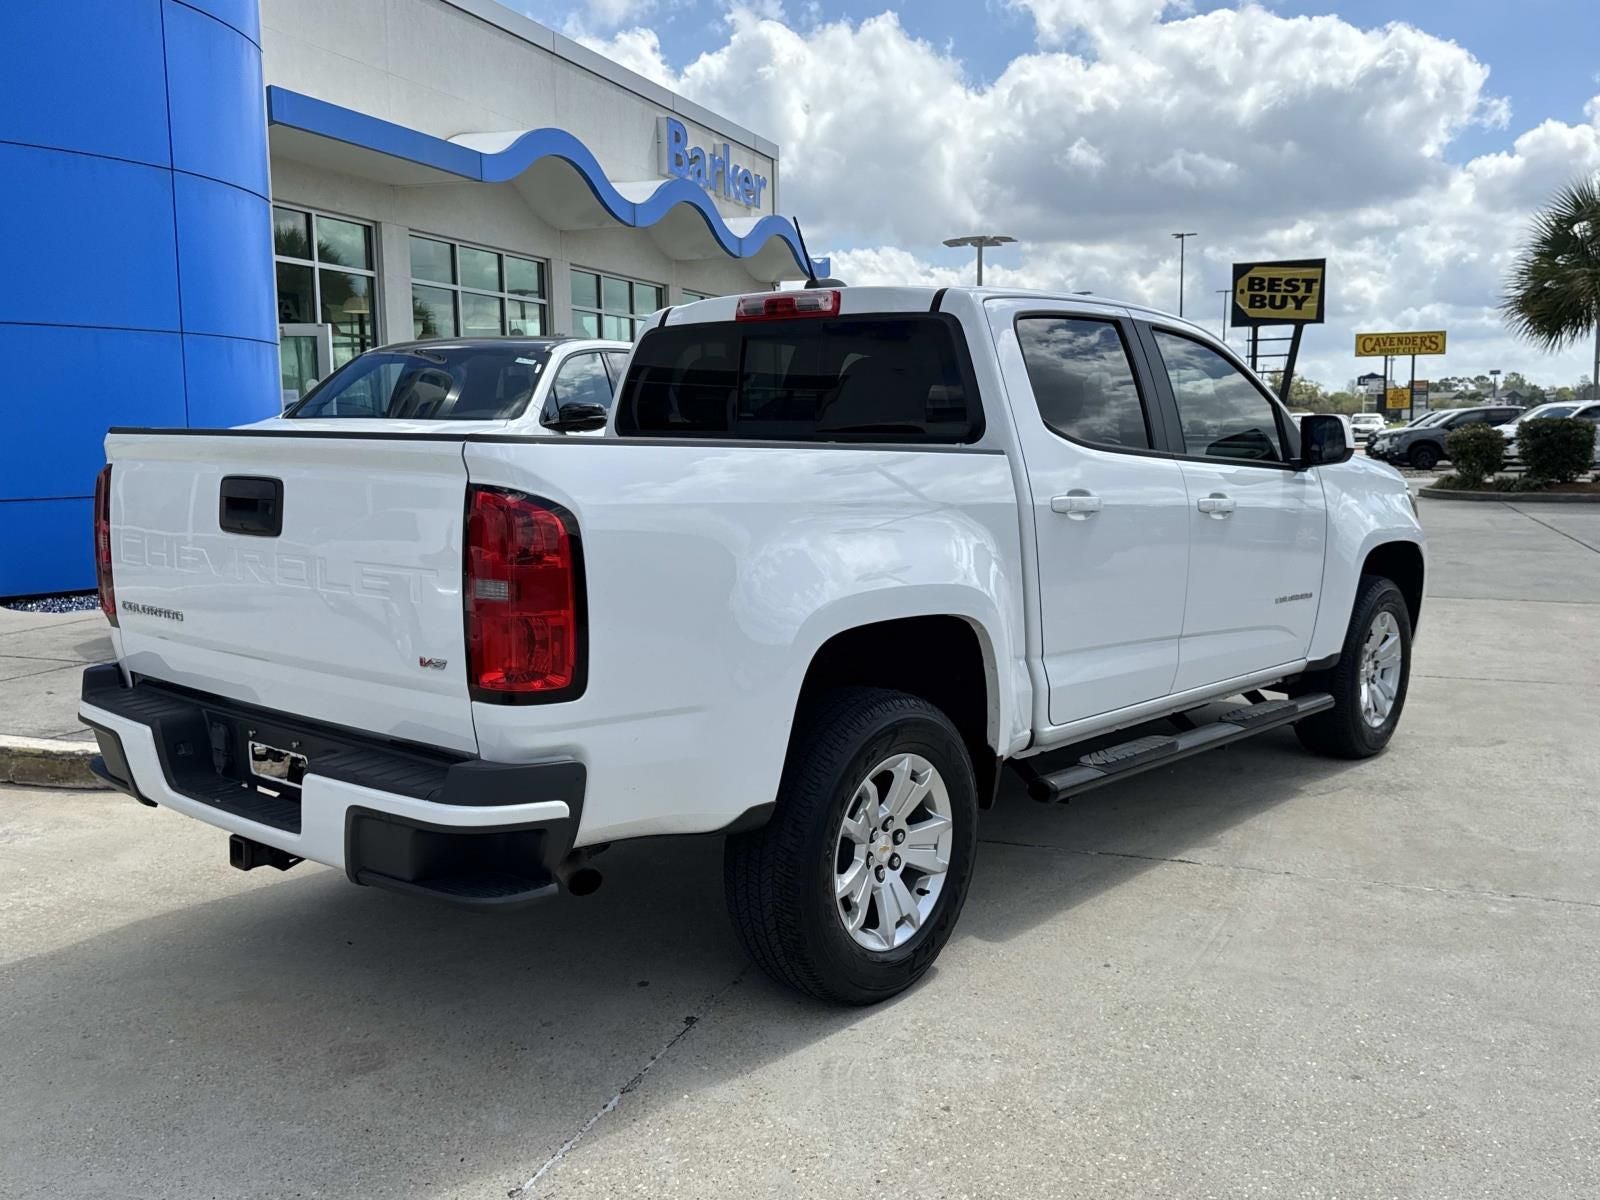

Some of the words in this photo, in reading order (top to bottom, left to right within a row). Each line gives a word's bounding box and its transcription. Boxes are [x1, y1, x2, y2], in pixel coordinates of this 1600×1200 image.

[666, 116, 767, 209] Barker
[1247, 276, 1318, 294] BEST
[1248, 293, 1311, 311] BUY
[1362, 334, 1439, 353] CAVENDER'S
[113, 533, 440, 604] CHEVROLET
